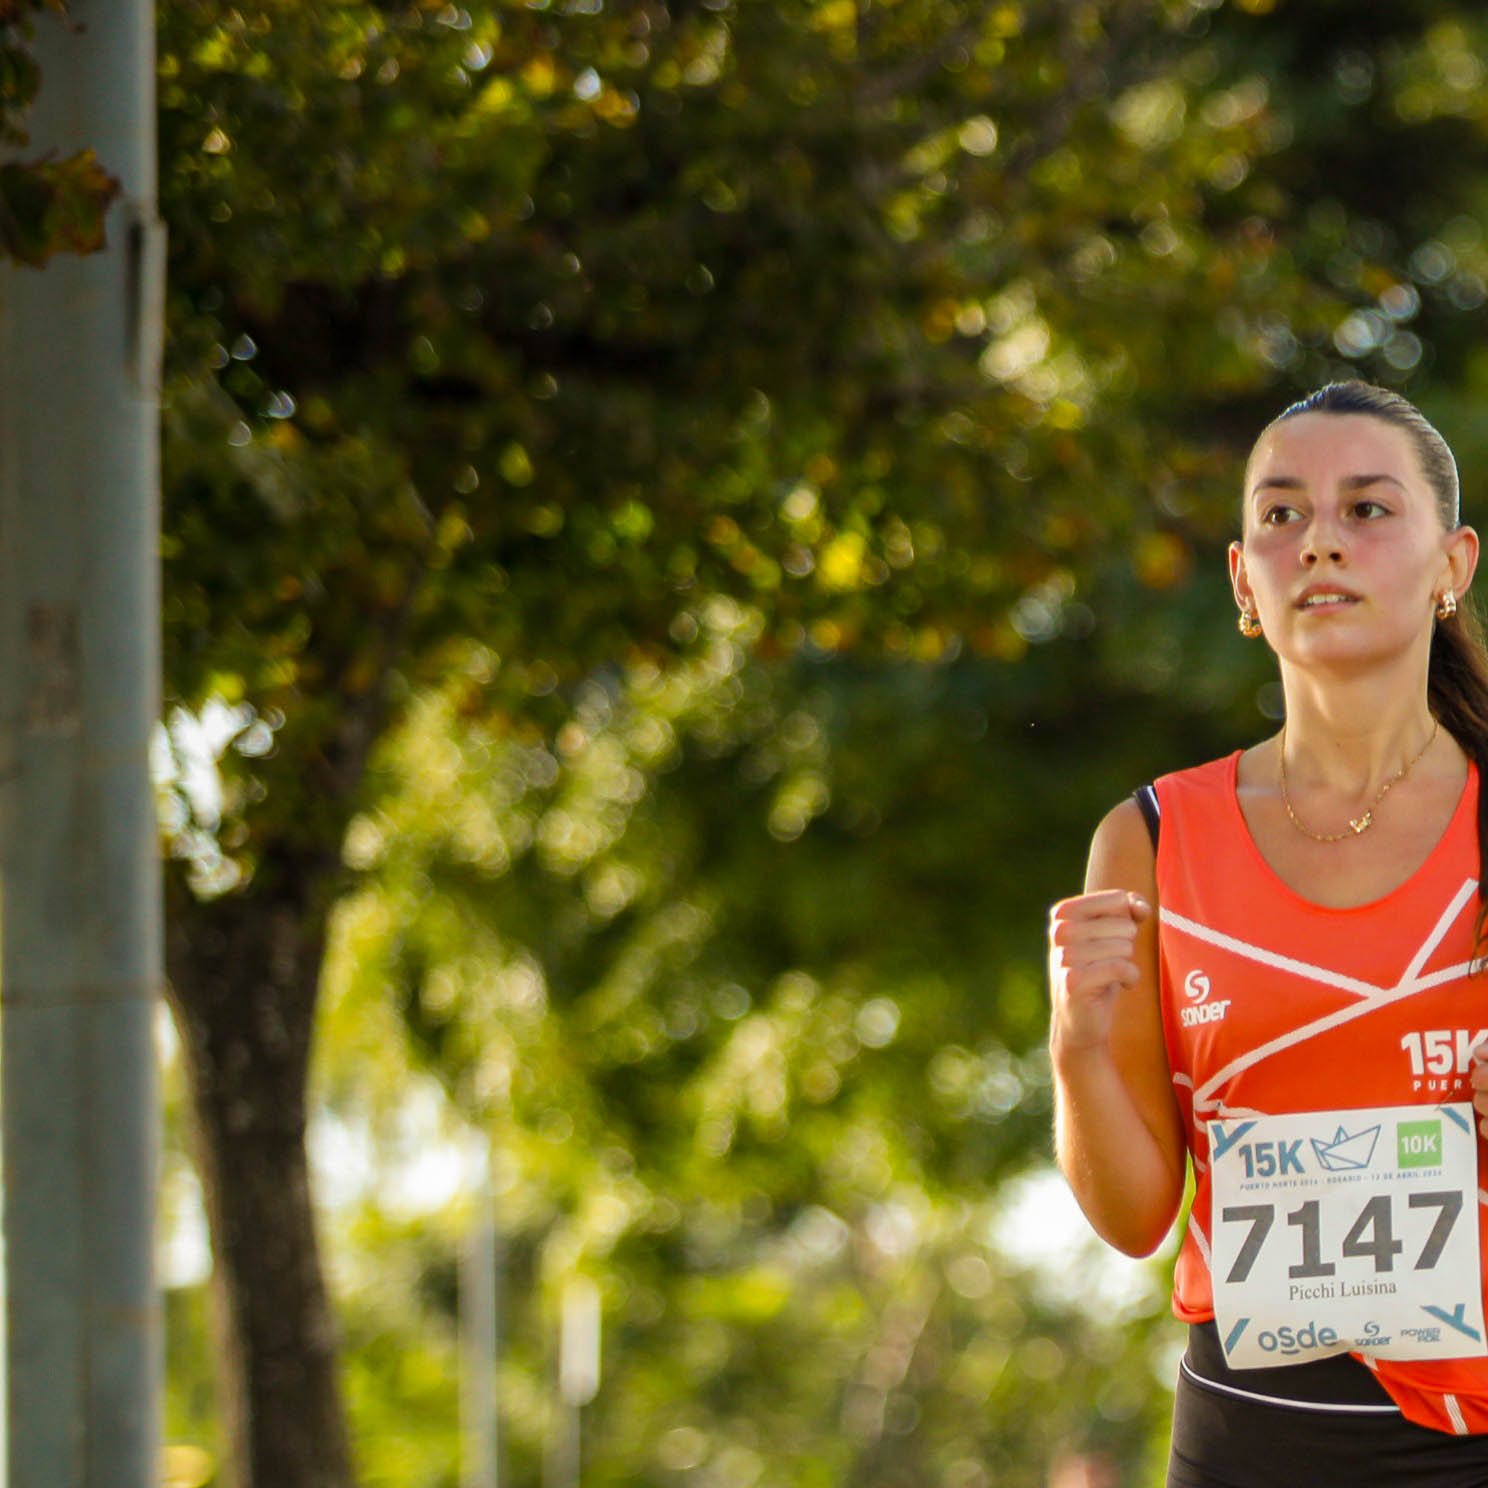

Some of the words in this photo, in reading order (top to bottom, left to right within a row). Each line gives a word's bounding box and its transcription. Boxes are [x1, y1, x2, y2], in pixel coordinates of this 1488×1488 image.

[1413, 1079, 1464, 1092] PUER
[1238, 1138, 1306, 1178] 15K
[1401, 1134, 1438, 1157] 10K
[1222, 1190, 1464, 1284] 7147
[1289, 1281, 1335, 1301] Picchi
[1340, 1278, 1397, 1299] Luisina
[1257, 1320, 1338, 1355] osde
